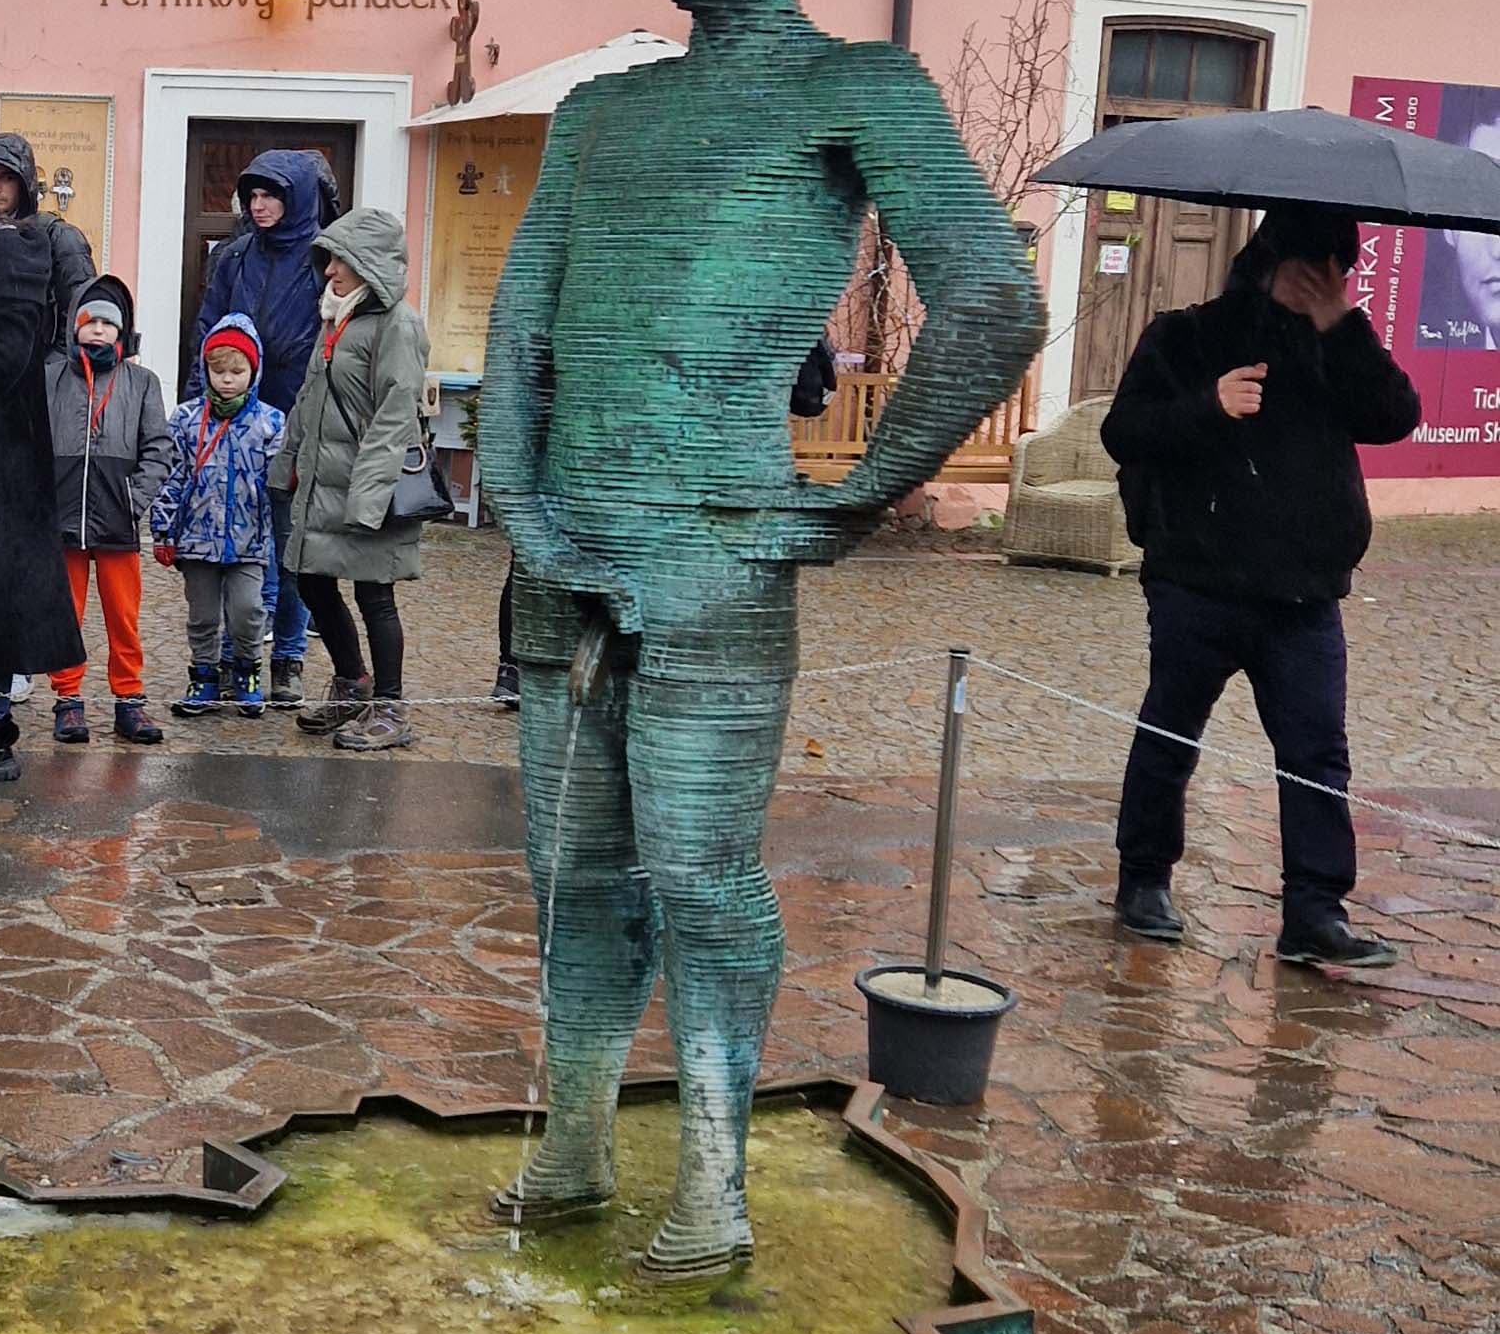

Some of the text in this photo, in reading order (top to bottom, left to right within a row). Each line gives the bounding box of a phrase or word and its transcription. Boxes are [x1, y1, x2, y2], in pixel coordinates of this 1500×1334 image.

[1393, 228, 1405, 264] open
[1356, 235, 1381, 320] AFKA
[1412, 422, 1480, 443] Museum
